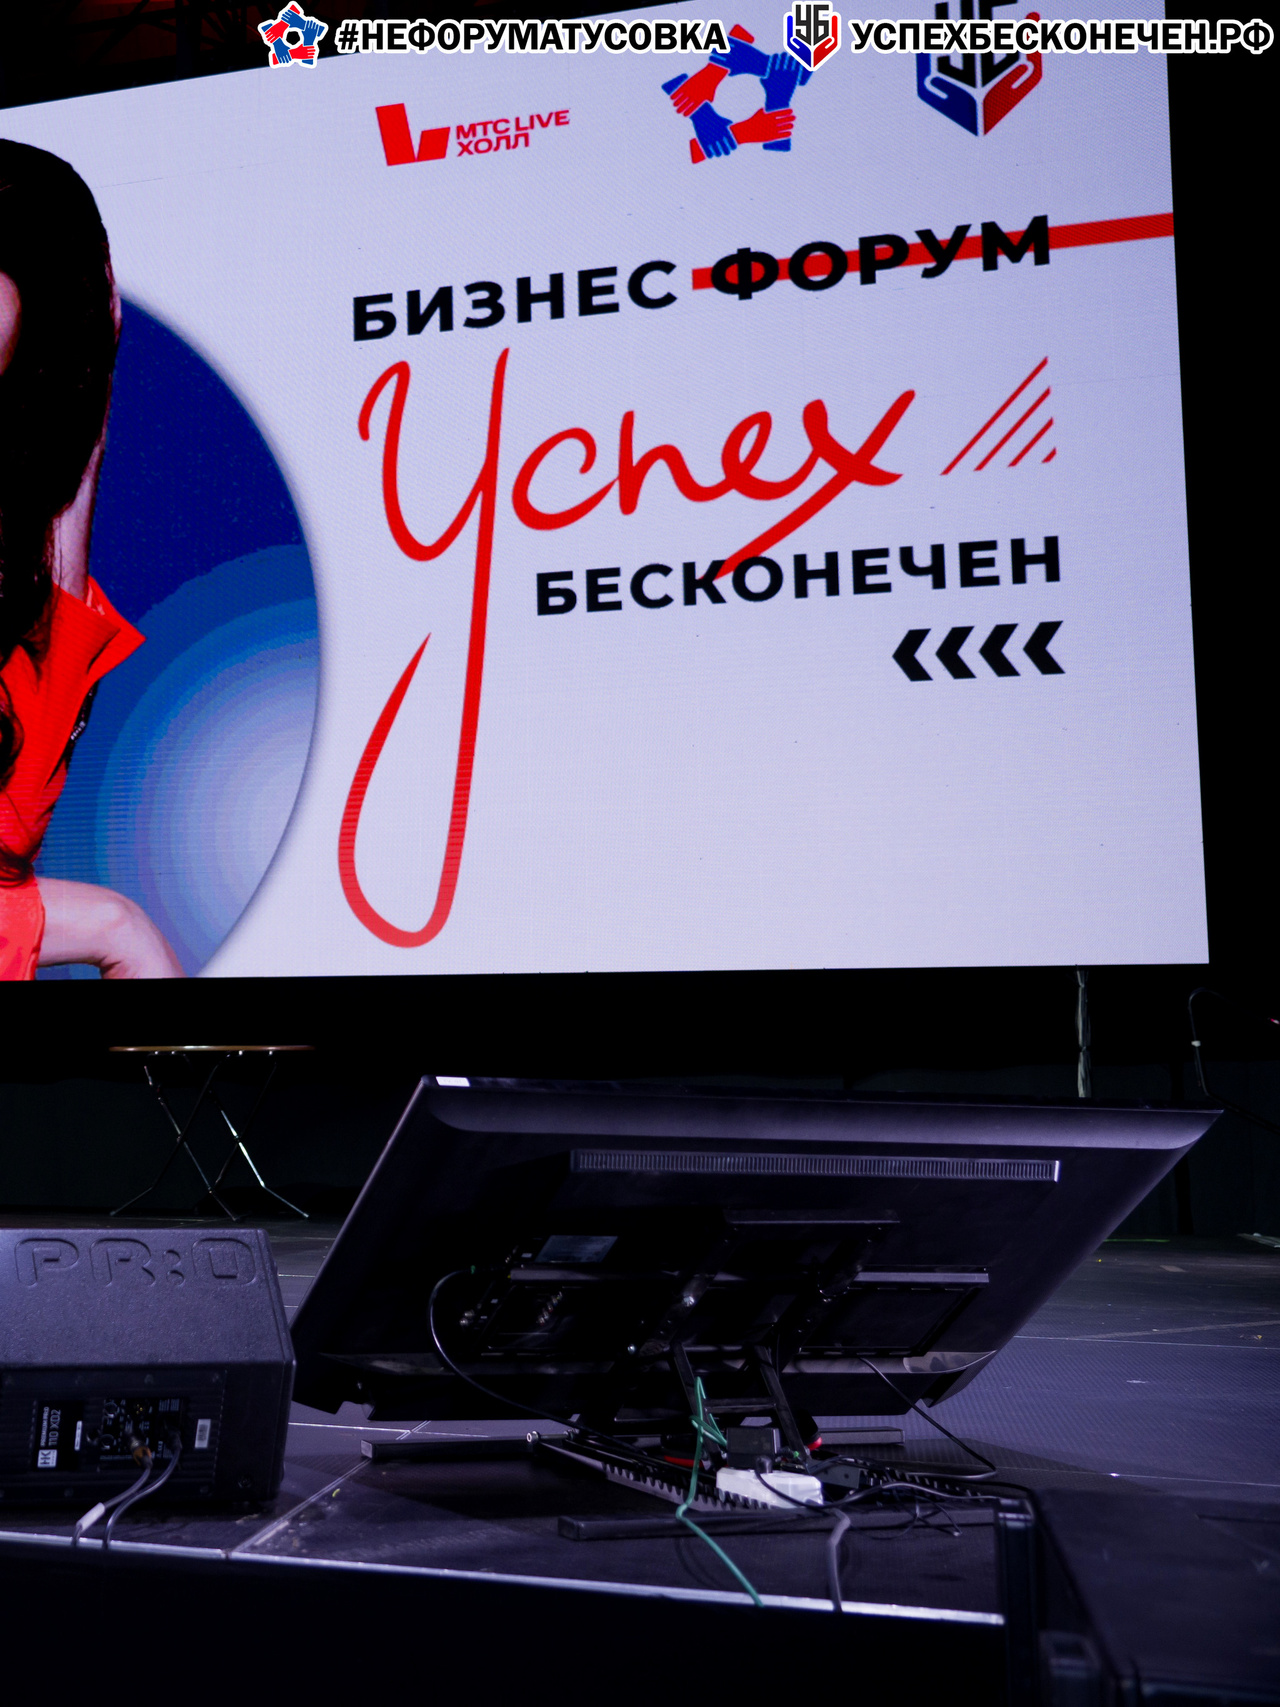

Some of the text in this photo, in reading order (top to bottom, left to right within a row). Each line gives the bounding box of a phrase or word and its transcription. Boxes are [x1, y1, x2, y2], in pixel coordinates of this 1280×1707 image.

[456, 109, 570, 140] МТС LIVE
[456, 132, 530, 157] ХОЛЛ
[353, 215, 1051, 341] БИЗНЕС ФОРУМ
[536, 535, 1061, 616] БЕСКОНЕЧЕН
